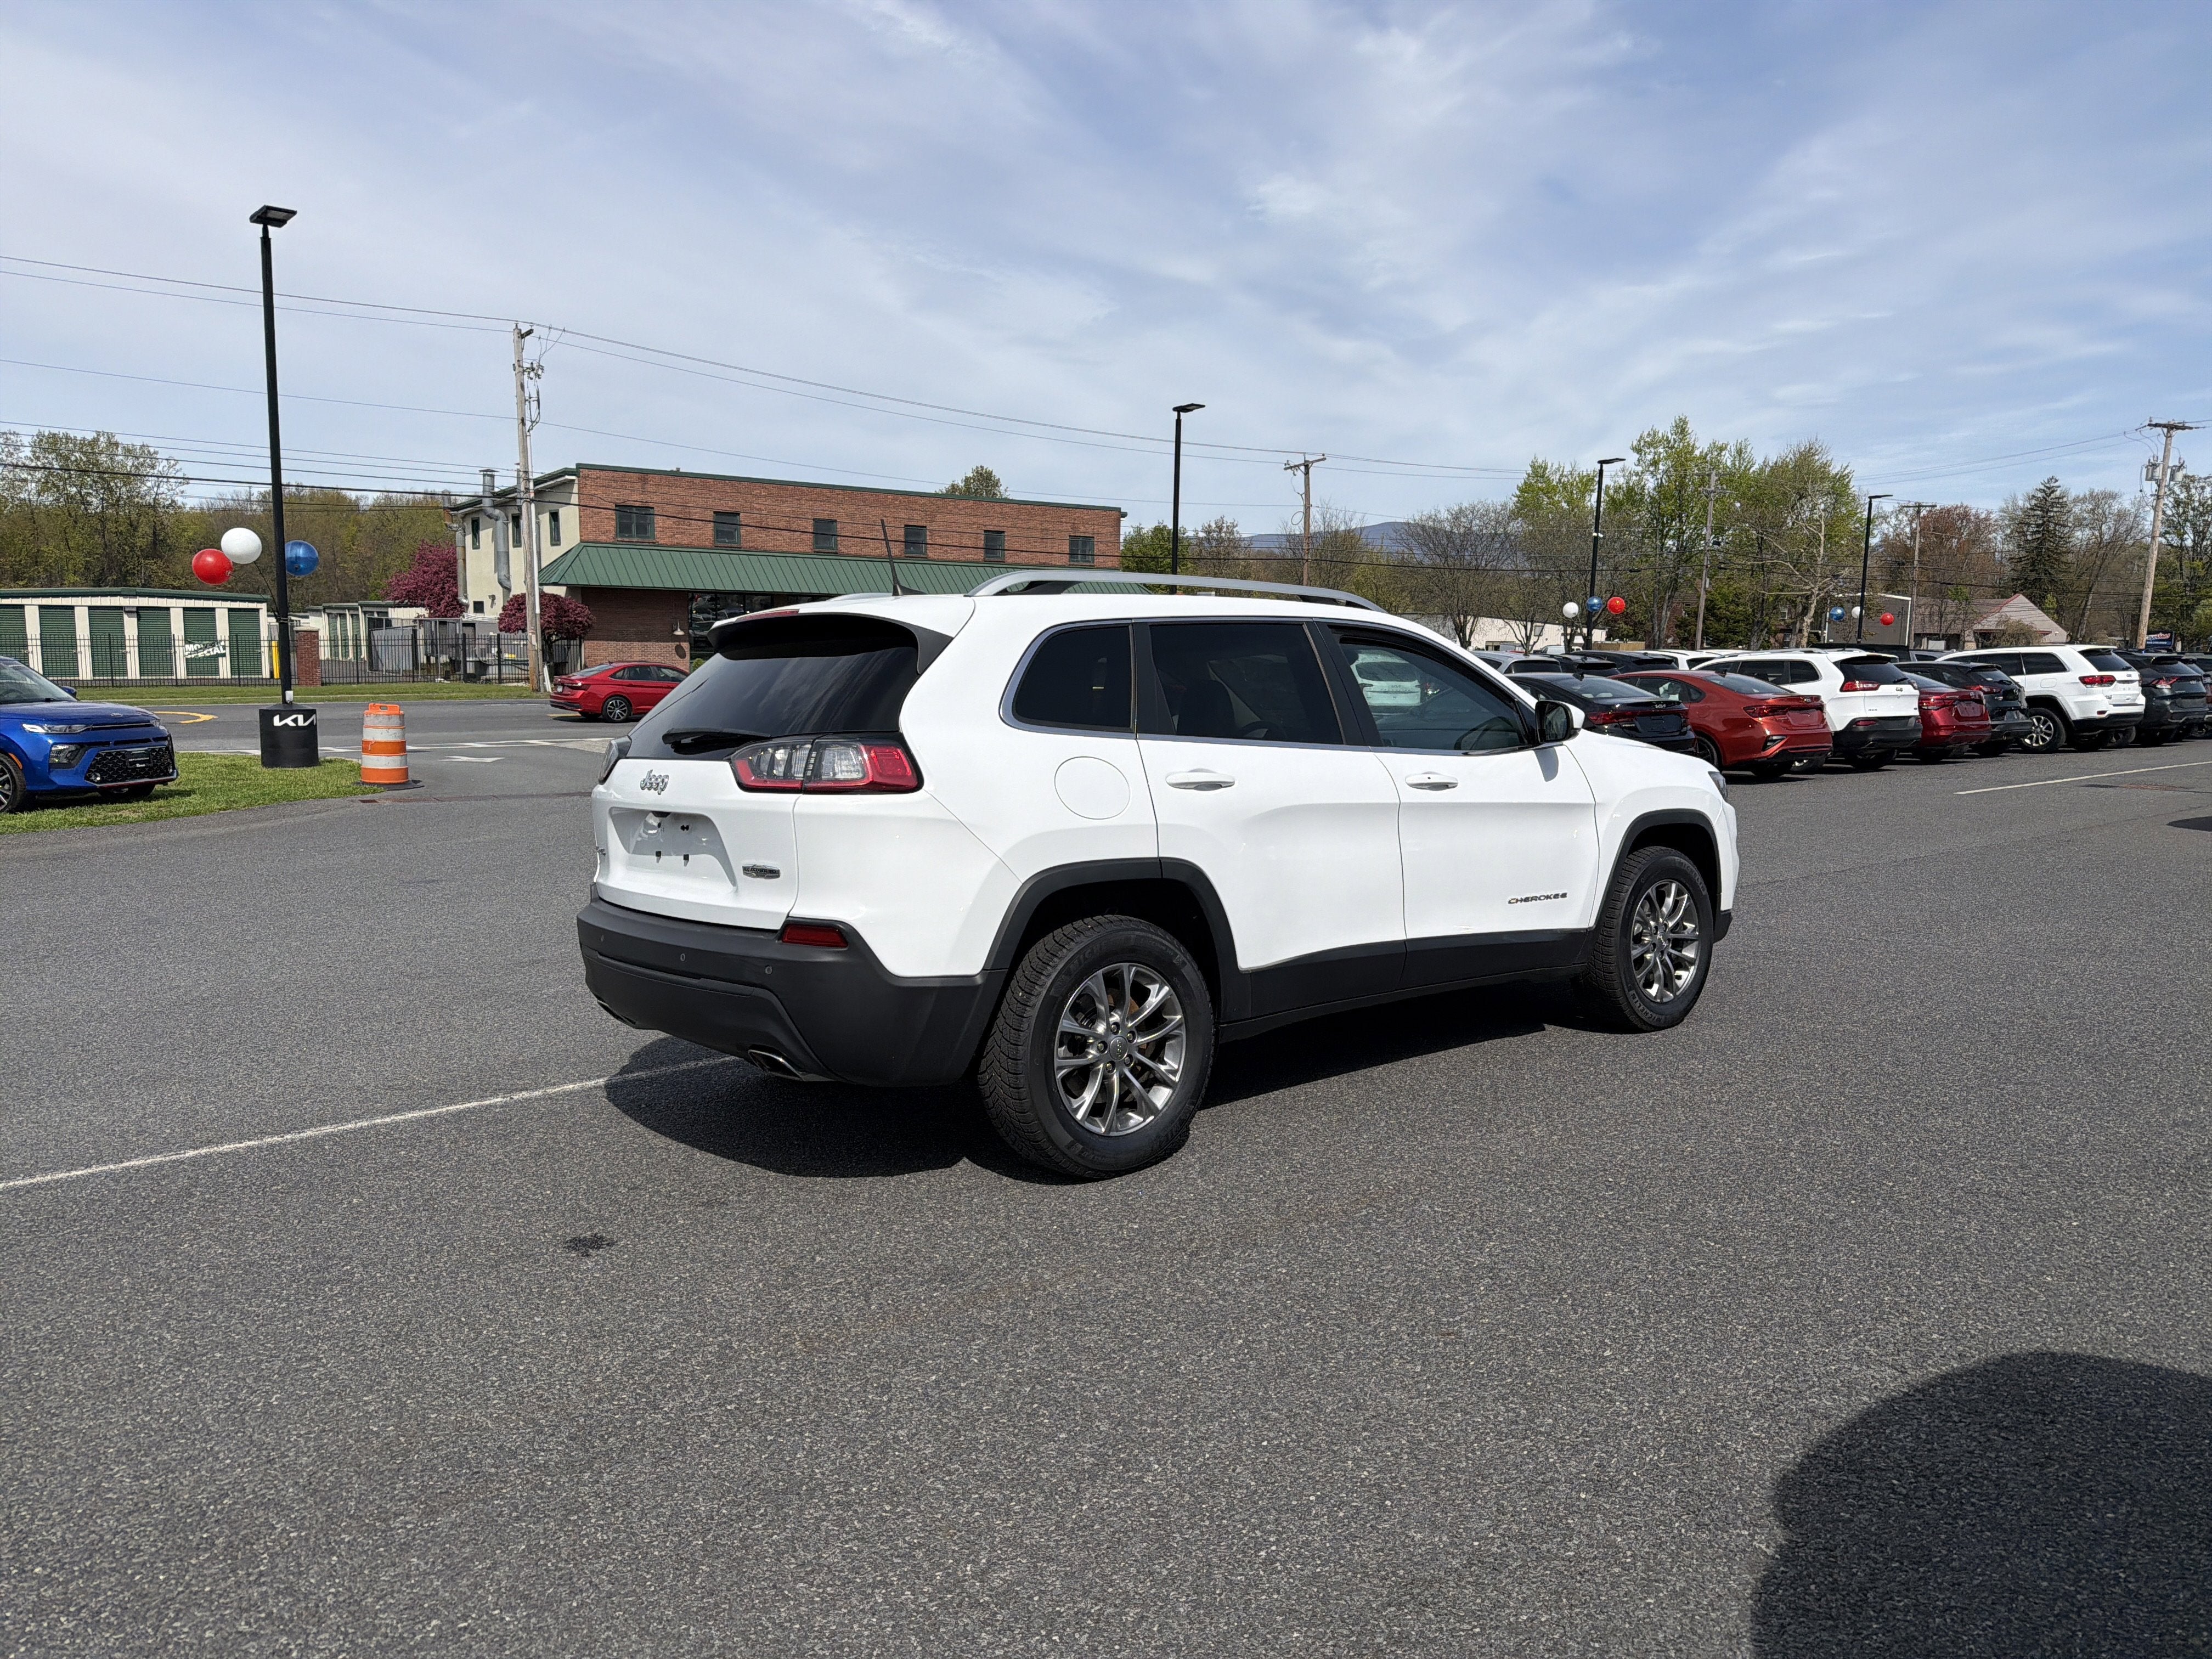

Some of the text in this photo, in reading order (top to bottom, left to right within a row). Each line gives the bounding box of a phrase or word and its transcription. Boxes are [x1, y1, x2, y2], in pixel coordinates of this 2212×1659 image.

[185, 646, 226, 658] SPECIAL
[273, 714, 317, 726] KIA
[640, 769, 669, 795] Jeep
[1508, 893, 1567, 904] CHEROKEE
